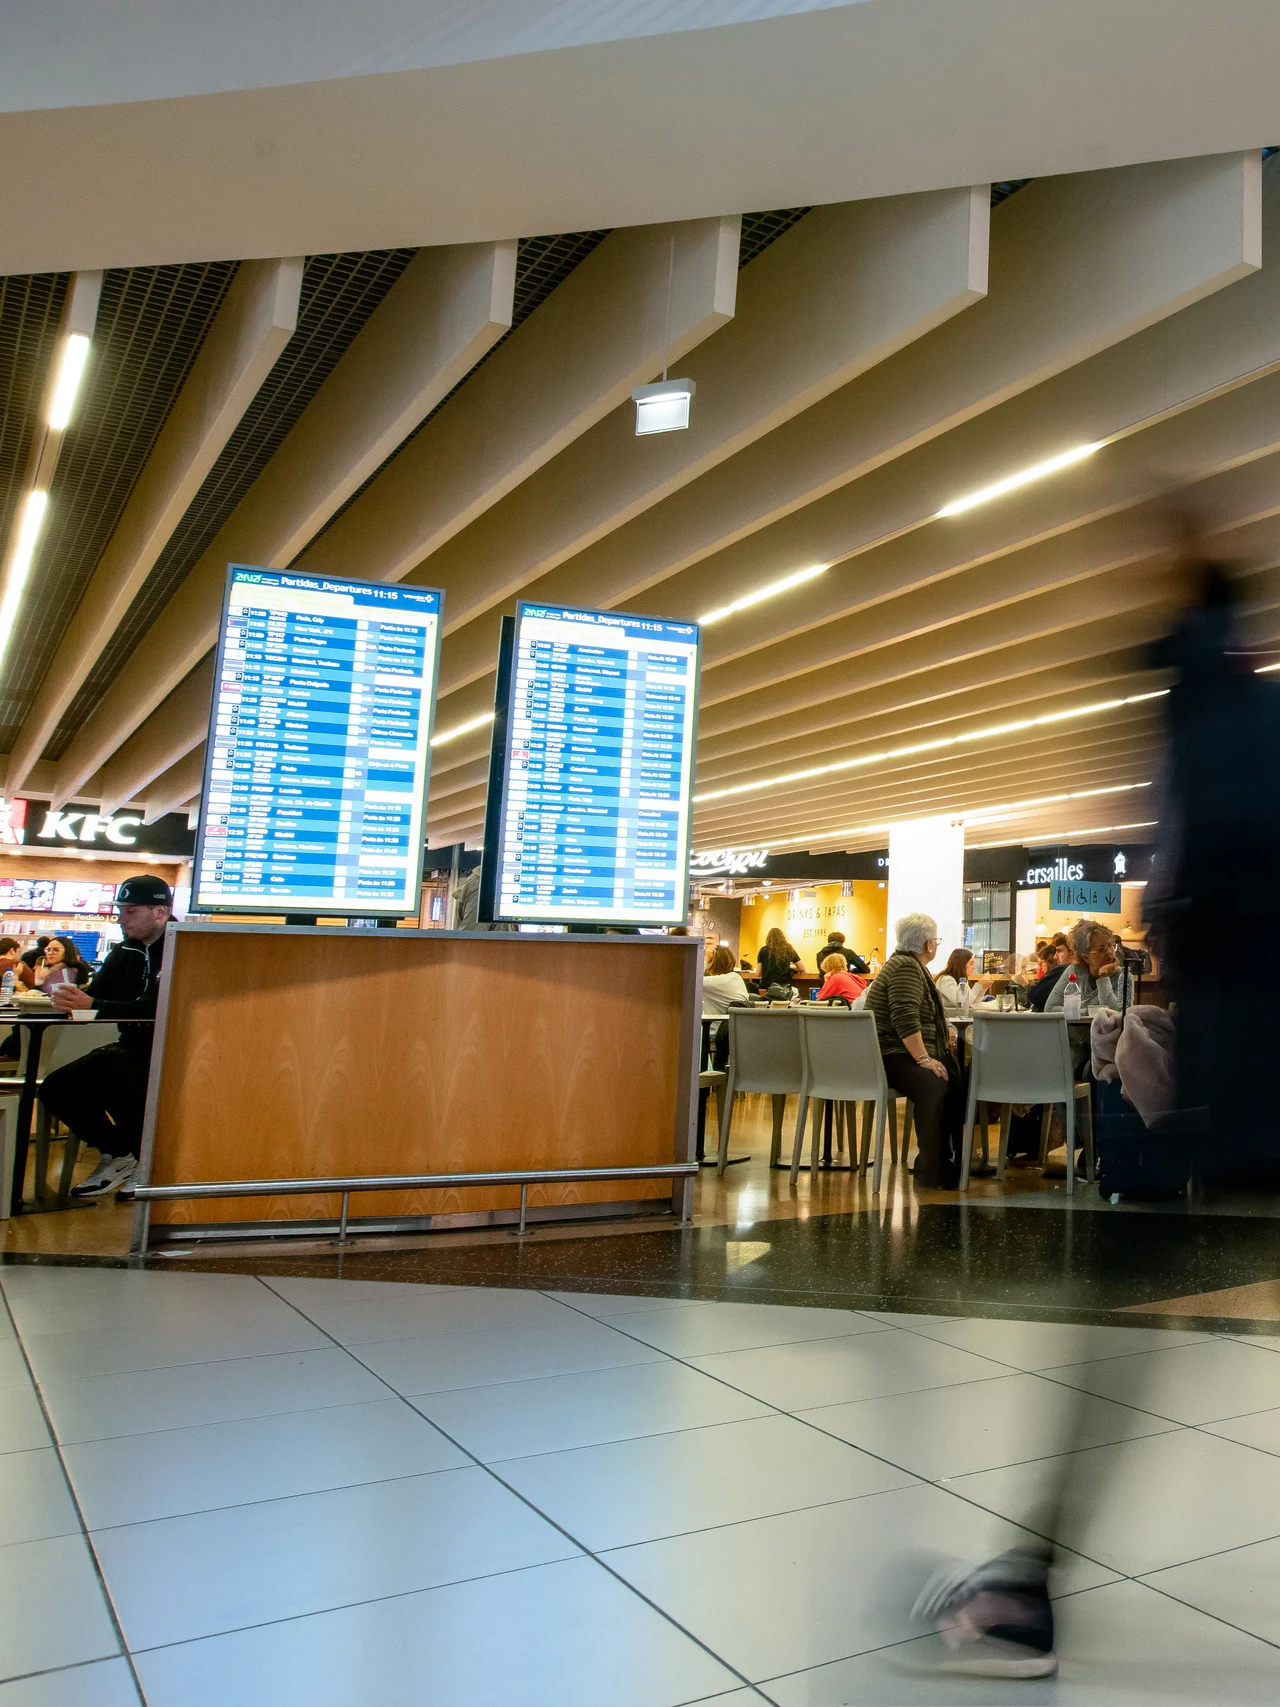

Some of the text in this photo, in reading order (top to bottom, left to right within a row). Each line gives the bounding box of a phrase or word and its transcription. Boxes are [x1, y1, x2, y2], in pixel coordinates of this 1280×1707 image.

[373, 589, 399, 600] 11:15
[641, 621, 663, 632] 11:15
[37, 810, 141, 845] KFC
[1026, 857, 1084, 885] ersailles
[74, 913, 105, 922] Pedido
[787, 910, 813, 921] DRINKS
[824, 905, 846, 917] TAPAS
[803, 926, 827, 939] EST 1995
